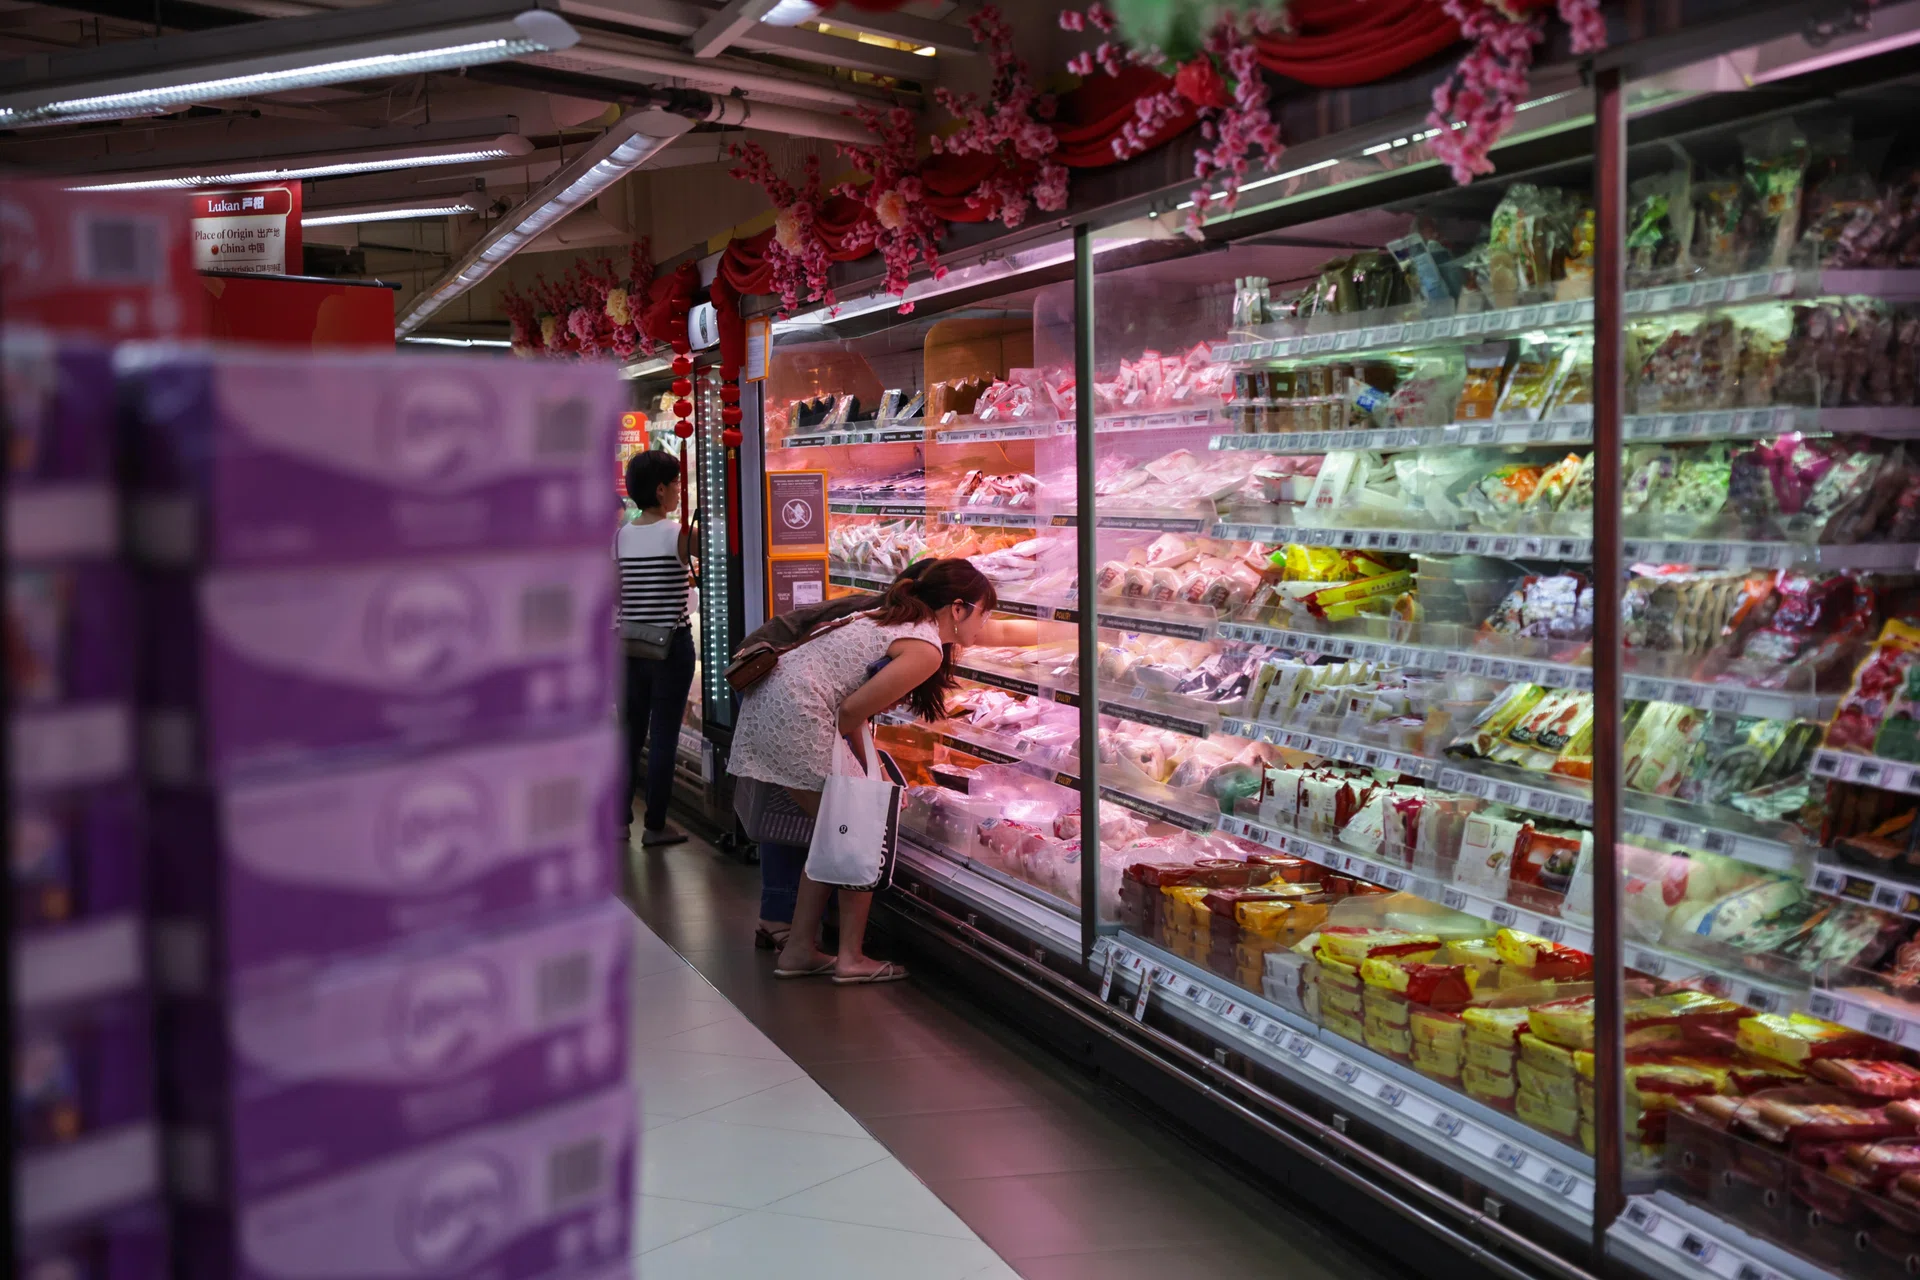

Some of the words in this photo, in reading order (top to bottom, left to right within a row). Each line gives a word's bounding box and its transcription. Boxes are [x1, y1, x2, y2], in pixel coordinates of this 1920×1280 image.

[208, 199, 240, 213] Lukan
[195, 230, 216, 240] Place
[216, 229, 226, 240] of
[226, 228, 254, 241] Origin
[257, 227, 280, 239] 出产地
[220, 243, 246, 254] China
[248, 242, 265, 254] 中国
